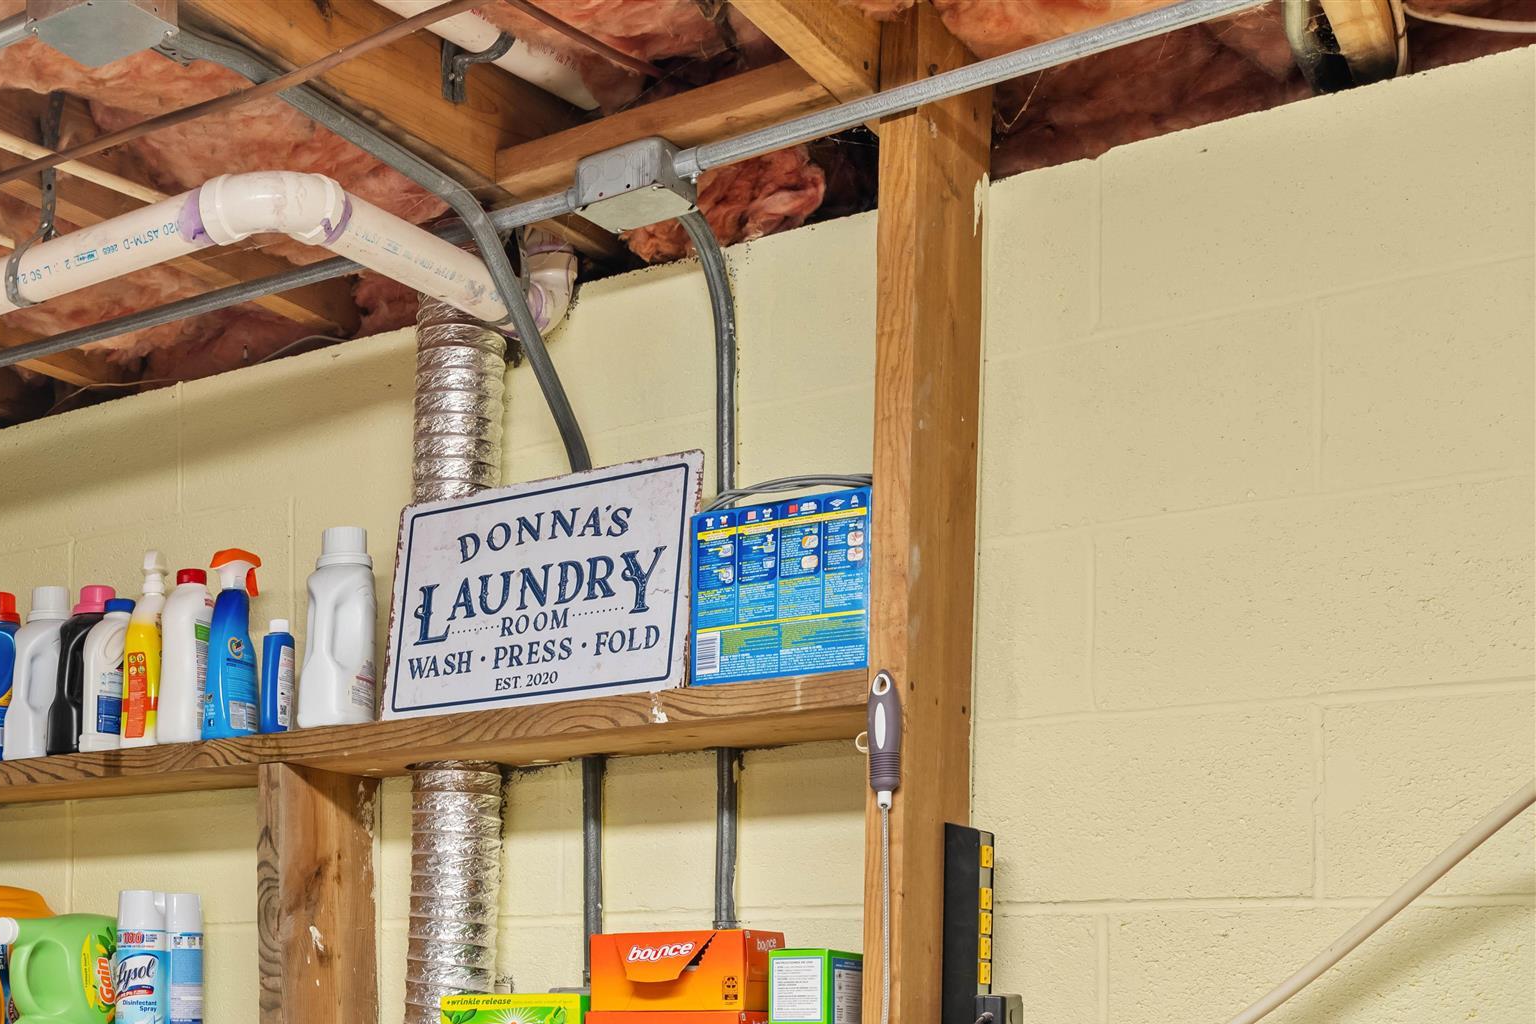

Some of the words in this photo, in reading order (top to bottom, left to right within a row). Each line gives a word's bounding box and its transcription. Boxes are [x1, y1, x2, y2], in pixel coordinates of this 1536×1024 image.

[458, 506, 634, 563] DONNA'S
[413, 545, 667, 646] LAUNDRY
[500, 609, 568, 637] ROOM
[408, 649, 472, 680] WASH
[493, 637, 573, 670] PRESS
[593, 624, 661, 656] FOLD
[494, 673, 523, 691] EST.
[526, 670, 559, 688] 2020
[627, 942, 694, 962] bounce
[756, 937, 776, 951] bounce
[96, 957, 115, 1004] Gain
